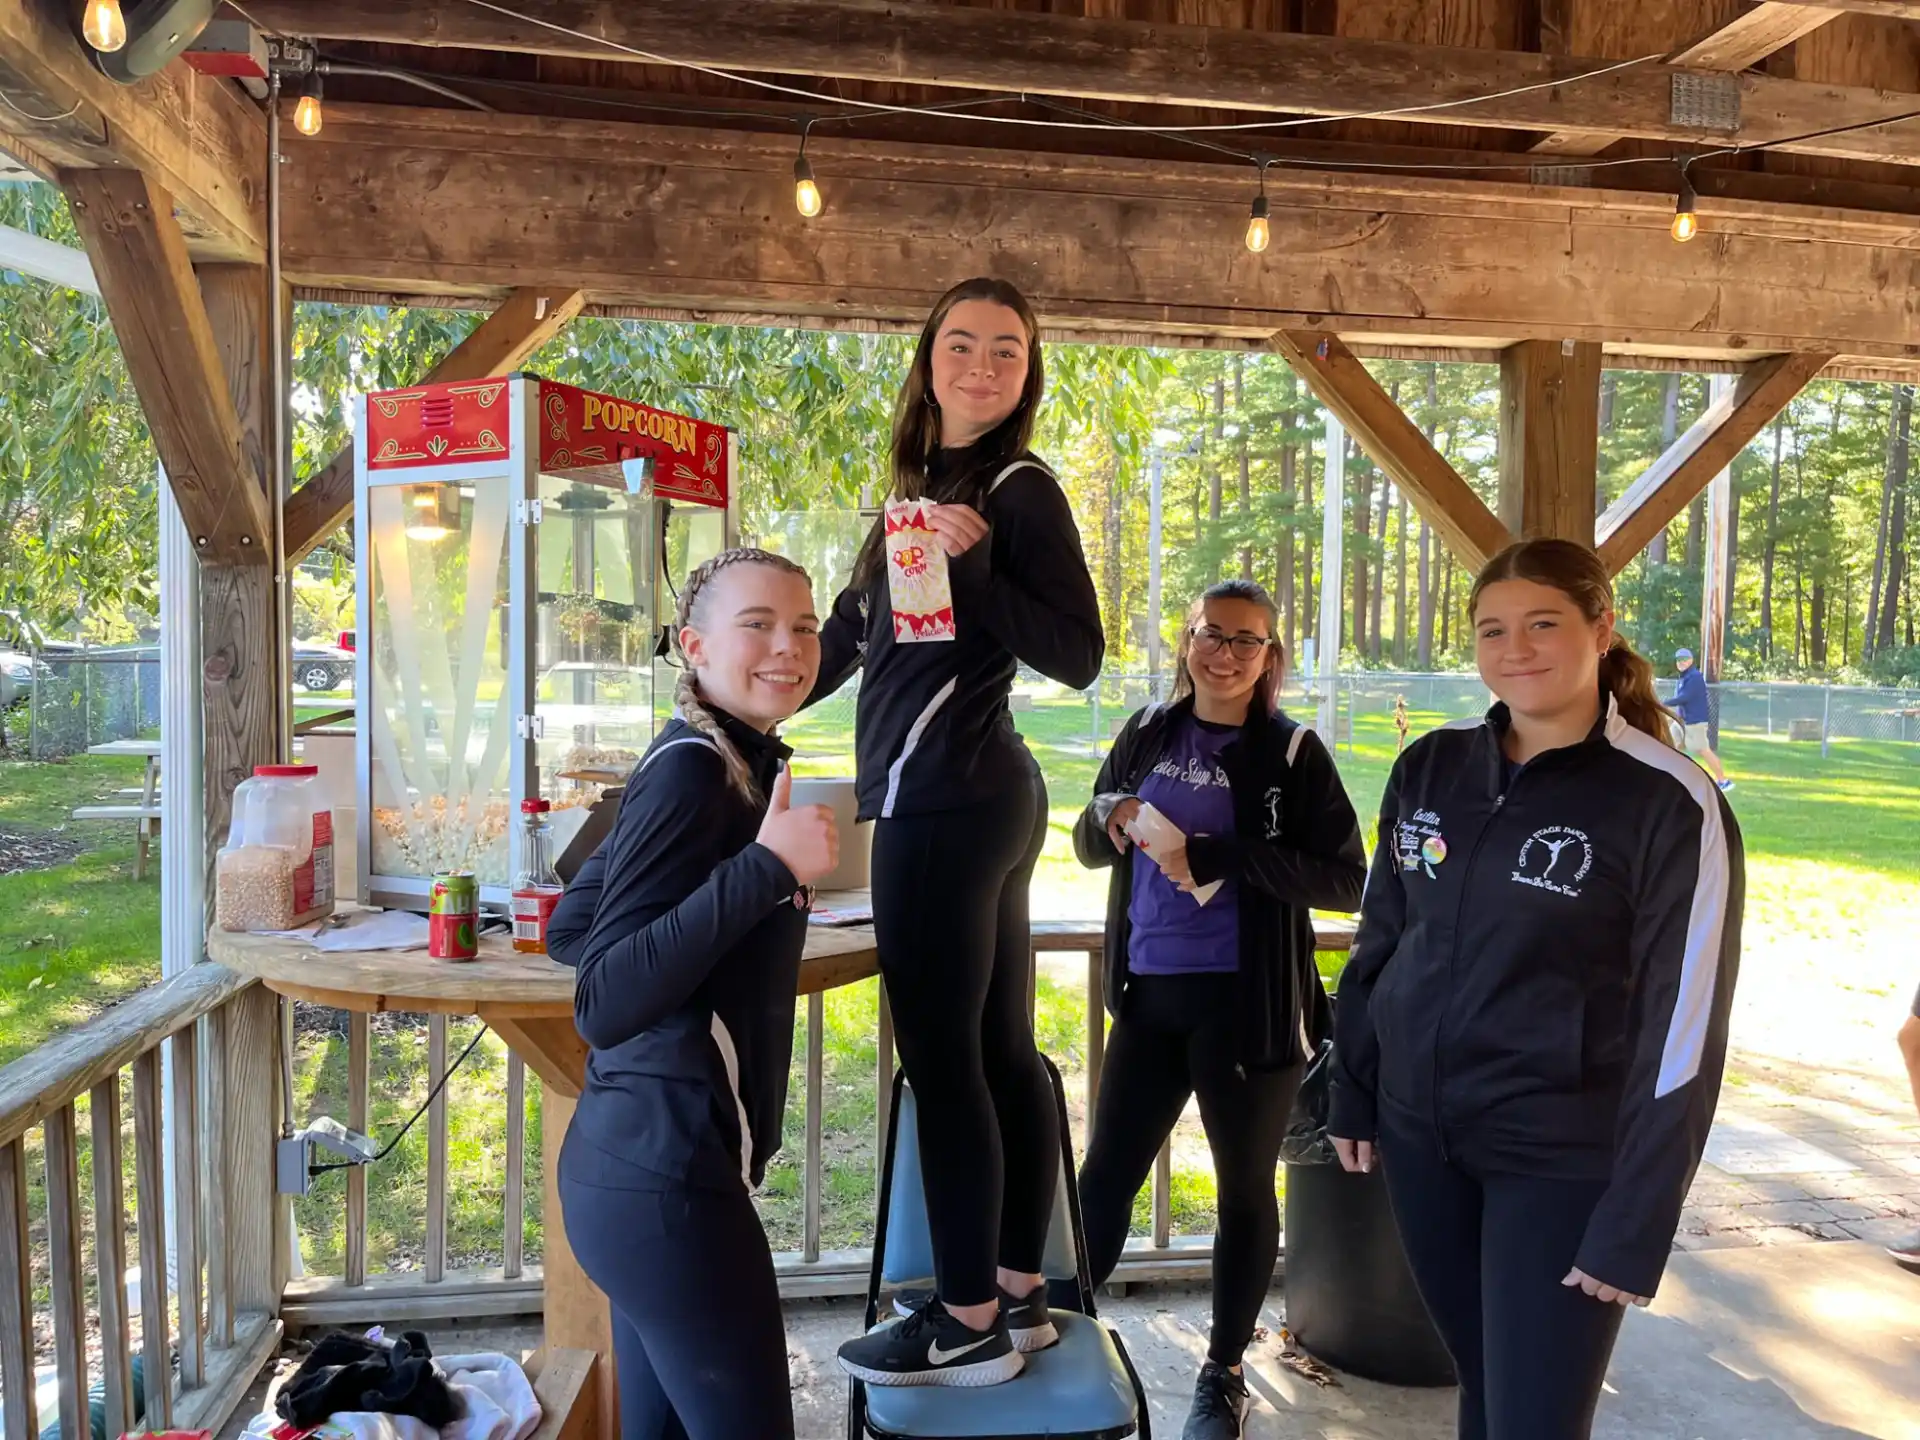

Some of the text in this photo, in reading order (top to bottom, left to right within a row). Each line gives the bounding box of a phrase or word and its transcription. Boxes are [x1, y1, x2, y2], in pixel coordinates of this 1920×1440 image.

[582, 394, 697, 457] POPCORN
[893, 546, 924, 568] POP
[904, 563, 927, 577] CORN
[1153, 759, 1181, 779] enter
[1413, 808, 1440, 825] Caitlin
[1519, 826, 1592, 882] CENTER STAGE DANCE ACADEMY
